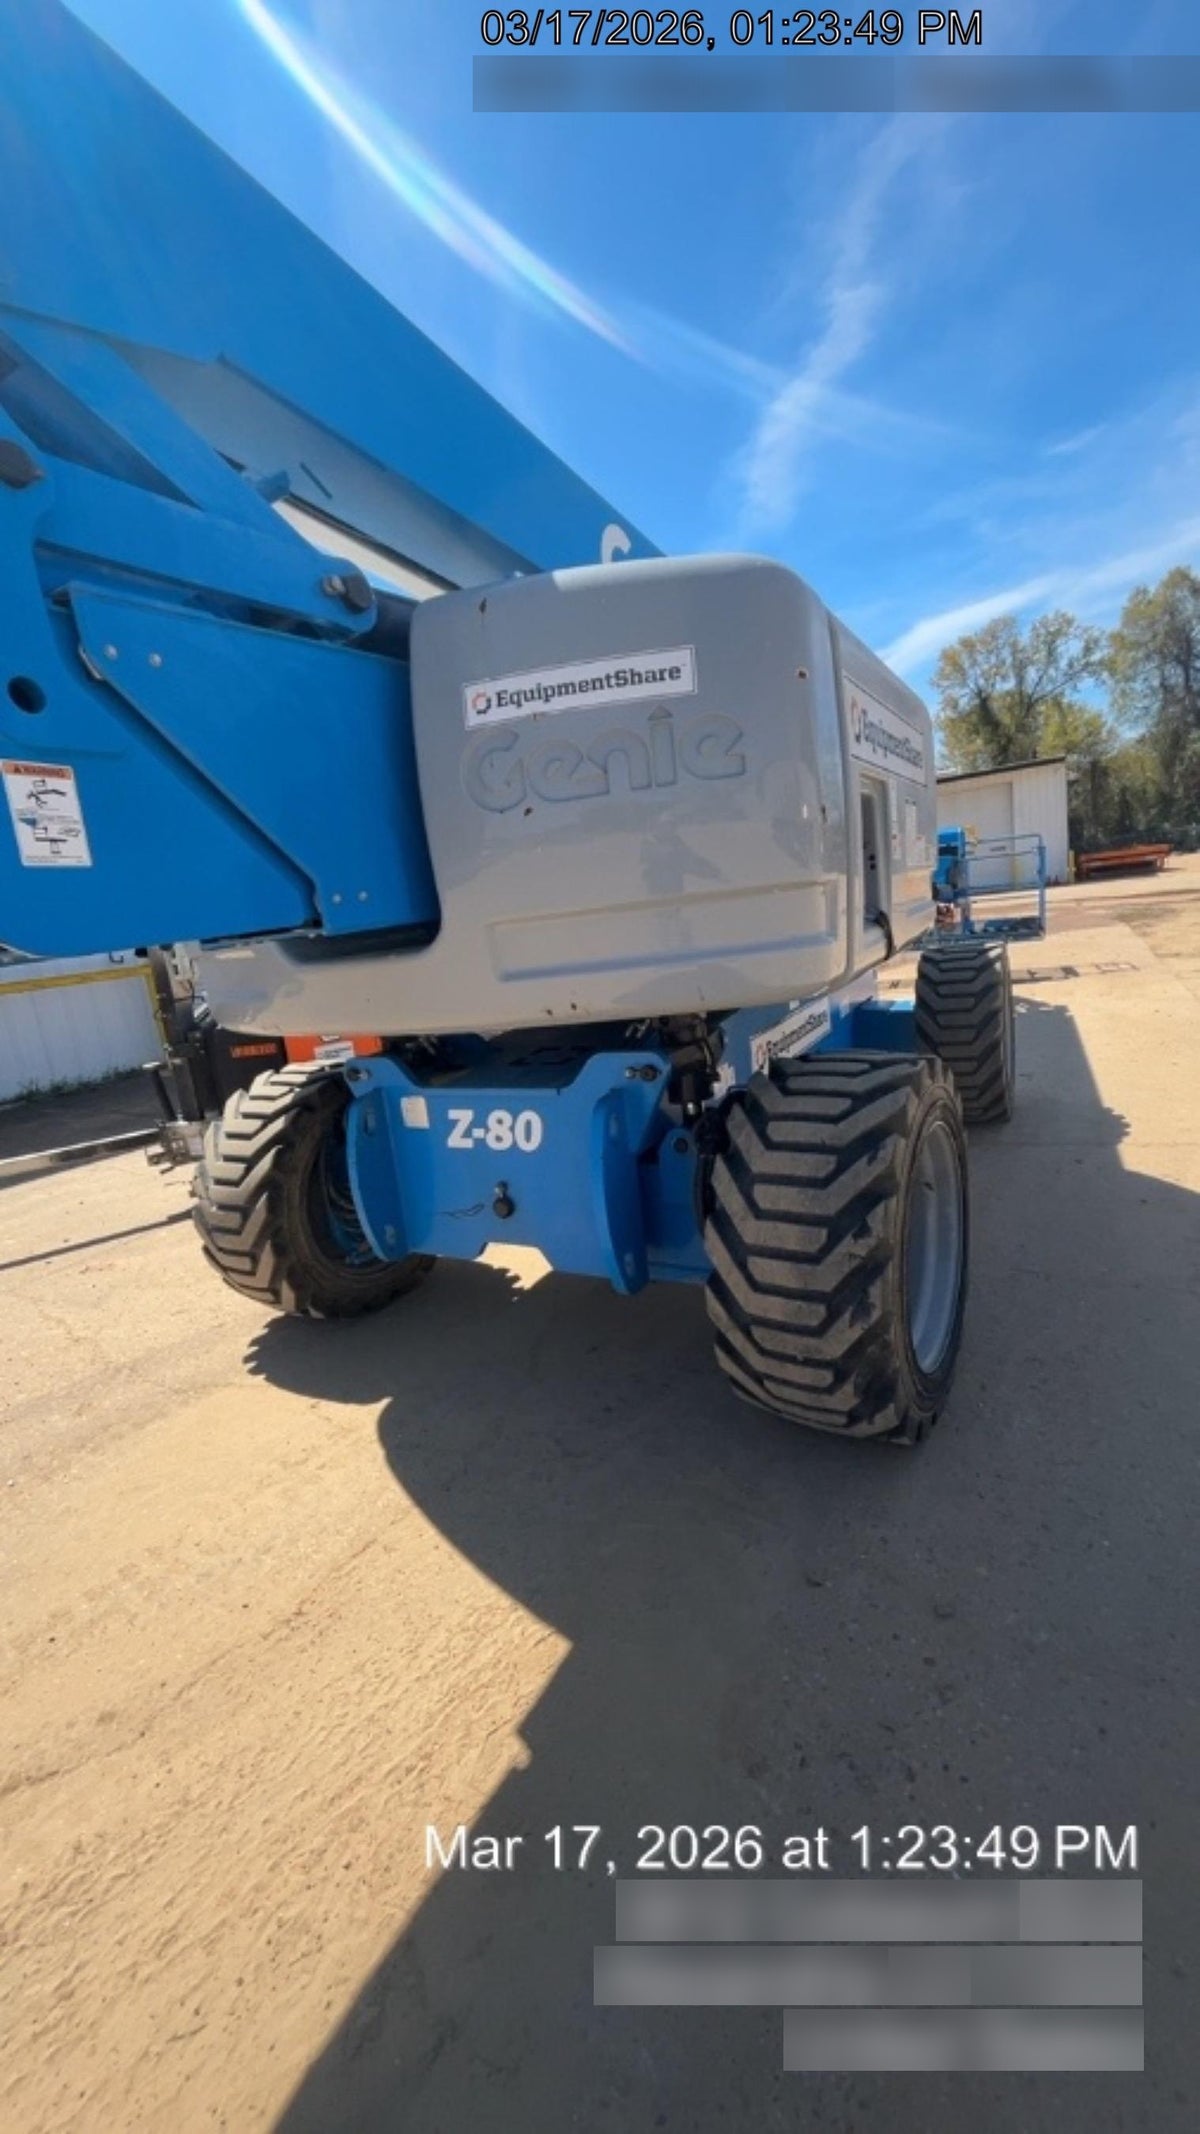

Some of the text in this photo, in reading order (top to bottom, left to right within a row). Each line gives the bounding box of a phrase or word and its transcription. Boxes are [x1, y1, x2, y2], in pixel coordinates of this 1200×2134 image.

[495, 664, 682, 709] EquipmentShare
[462, 704, 746, 813] Genie
[447, 1108, 542, 1151] Z-80
